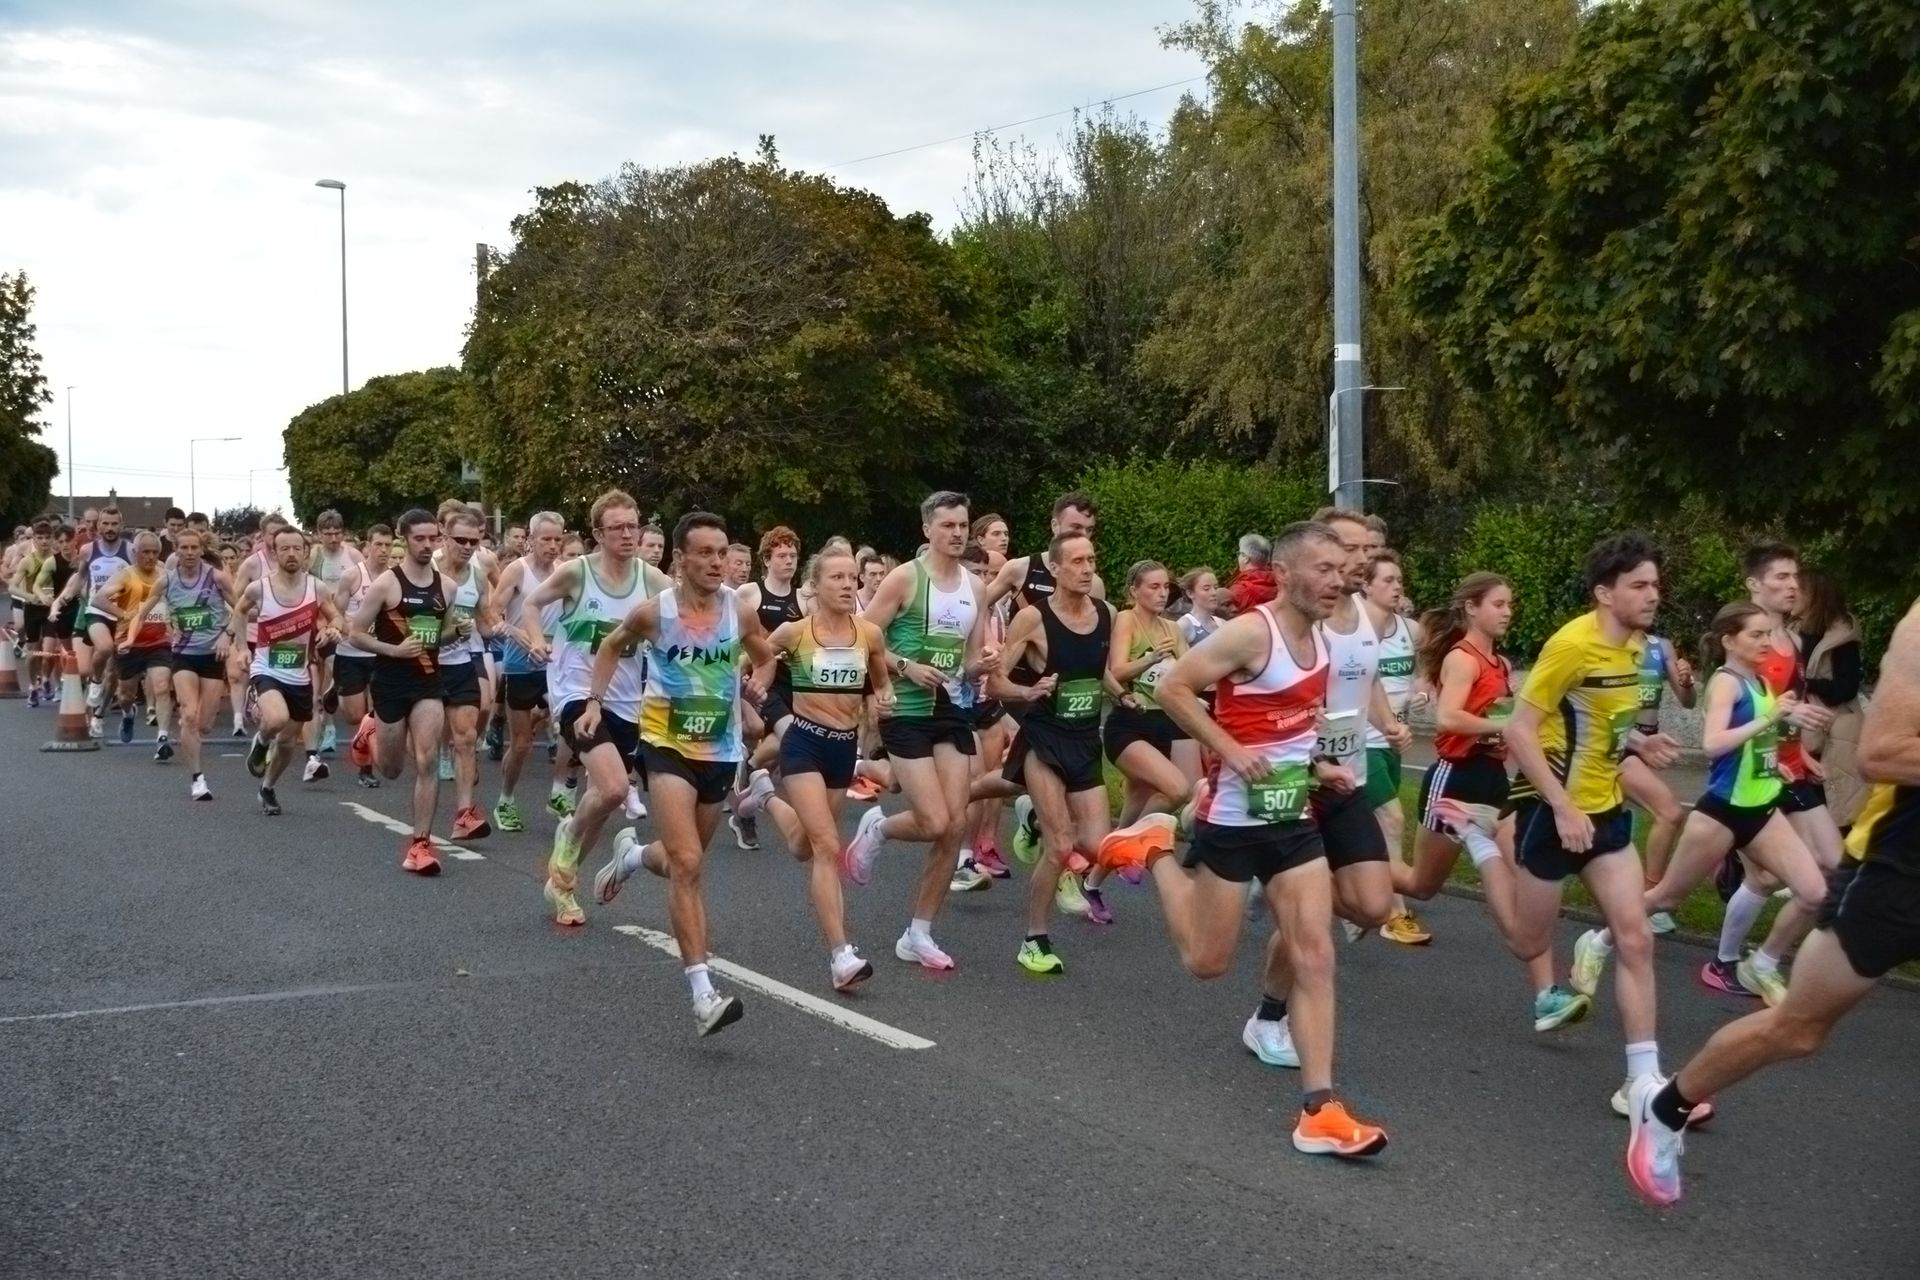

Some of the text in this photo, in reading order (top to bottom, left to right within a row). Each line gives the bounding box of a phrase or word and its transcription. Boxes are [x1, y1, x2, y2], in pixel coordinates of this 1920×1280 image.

[144, 612, 164, 621] 096
[184, 615, 203, 627] 727
[411, 631, 437, 643] 118
[277, 653, 298, 664] 897
[930, 652, 954, 668] 403
[820, 669, 858, 682] 5179
[1068, 696, 1093, 711] 222
[682, 716, 716, 733] 487
[793, 717, 855, 741] NIKE PRO
[1317, 734, 1356, 753] 5131
[1263, 788, 1298, 811] 507
